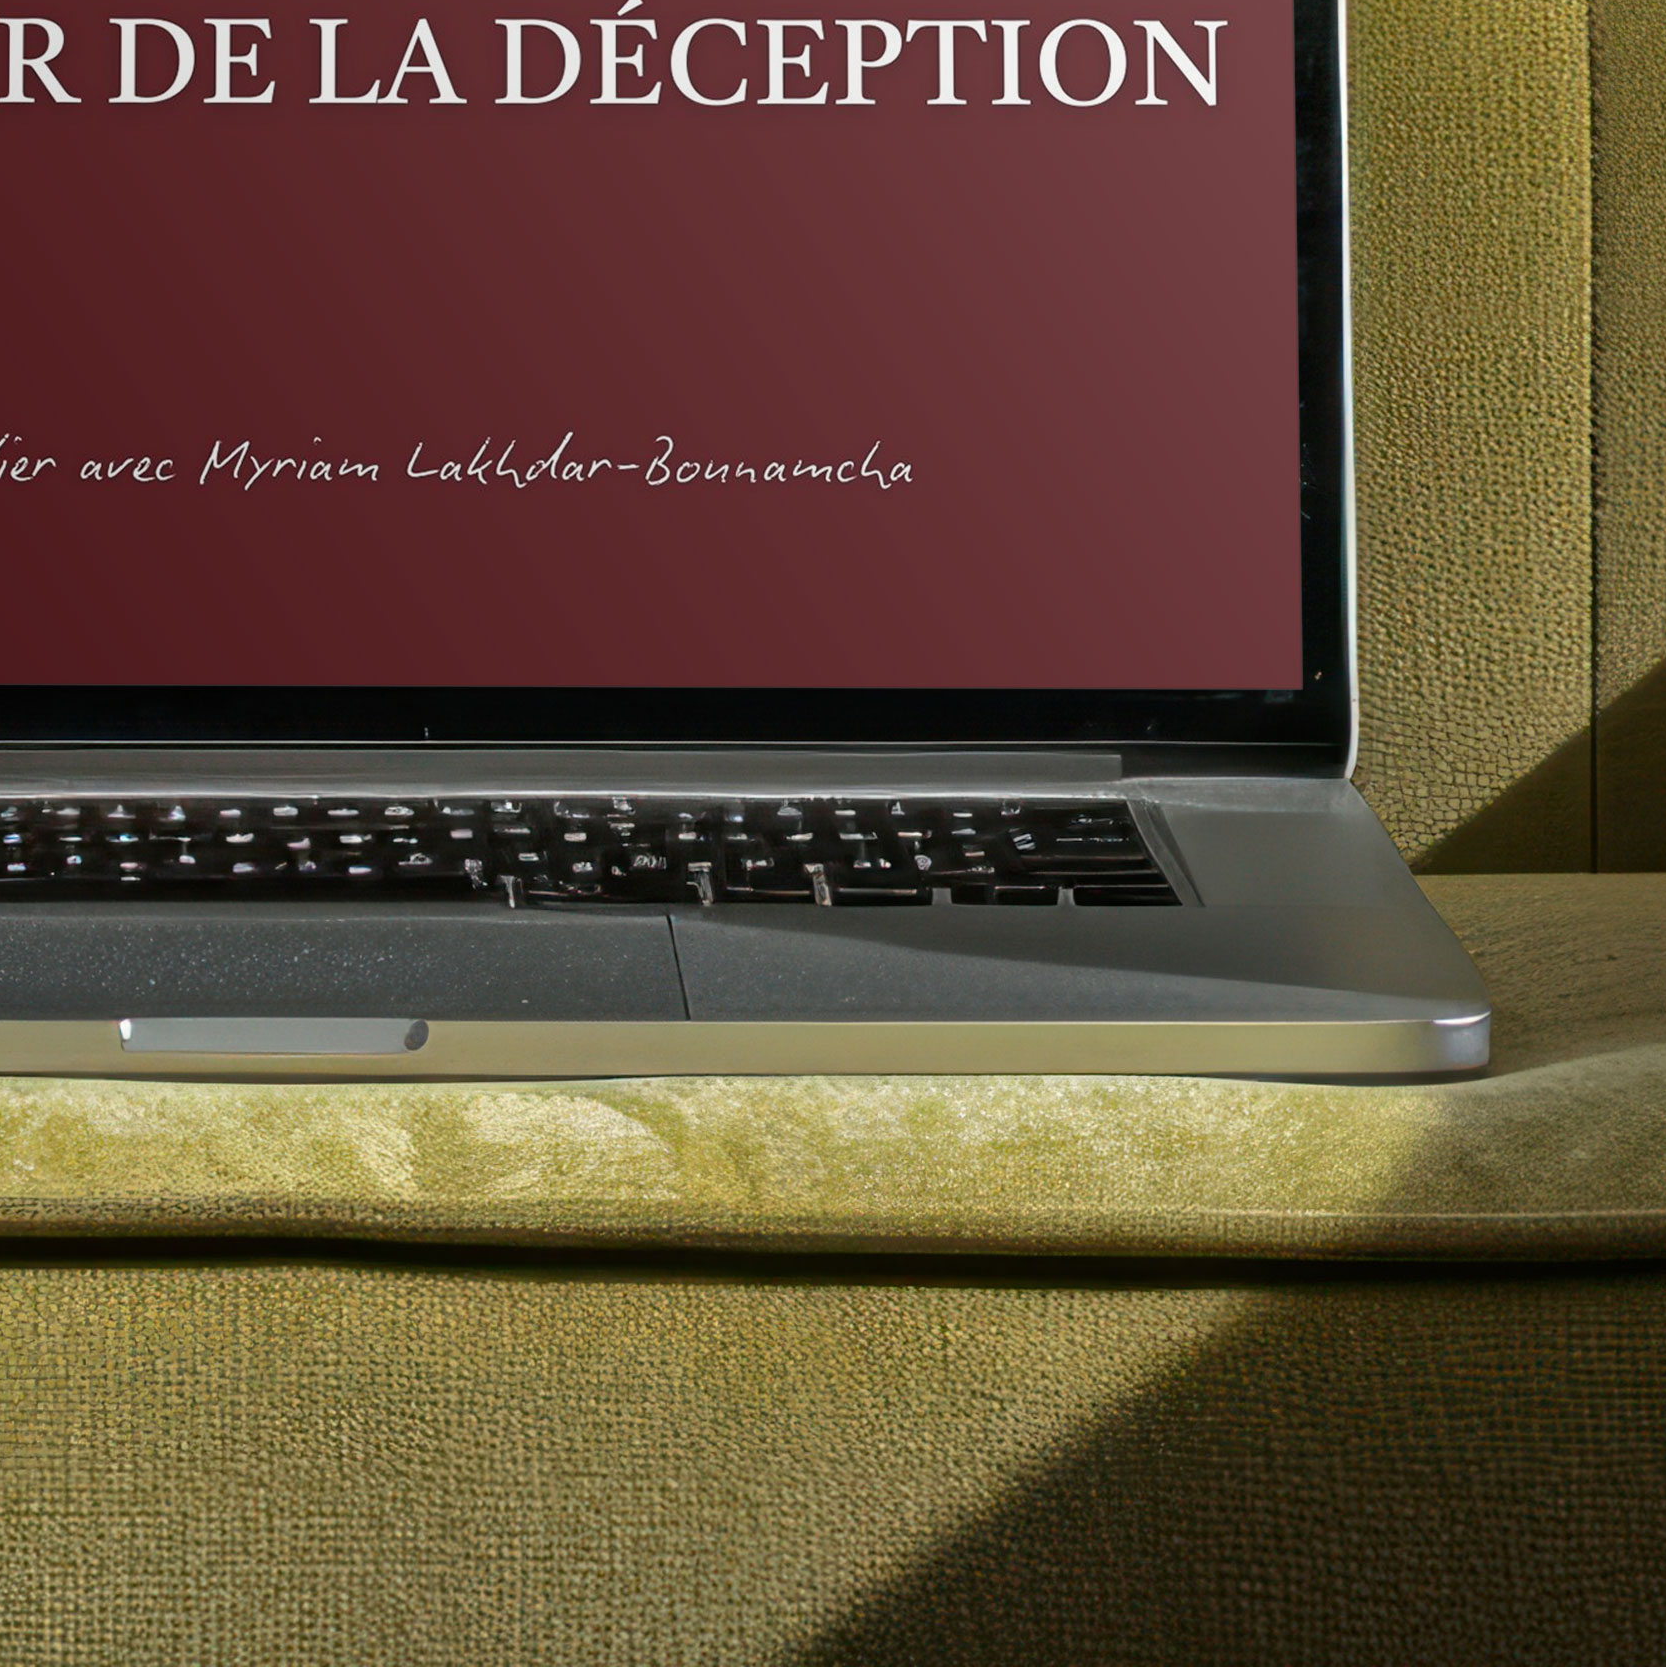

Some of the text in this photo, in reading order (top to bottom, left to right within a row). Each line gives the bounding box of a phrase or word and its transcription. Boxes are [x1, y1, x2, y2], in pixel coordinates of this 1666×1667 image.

[108, 17, 276, 104] DE
[308, 17, 468, 105] LA
[79, 456, 176, 483] avec
[199, 436, 380, 492] Myriam
